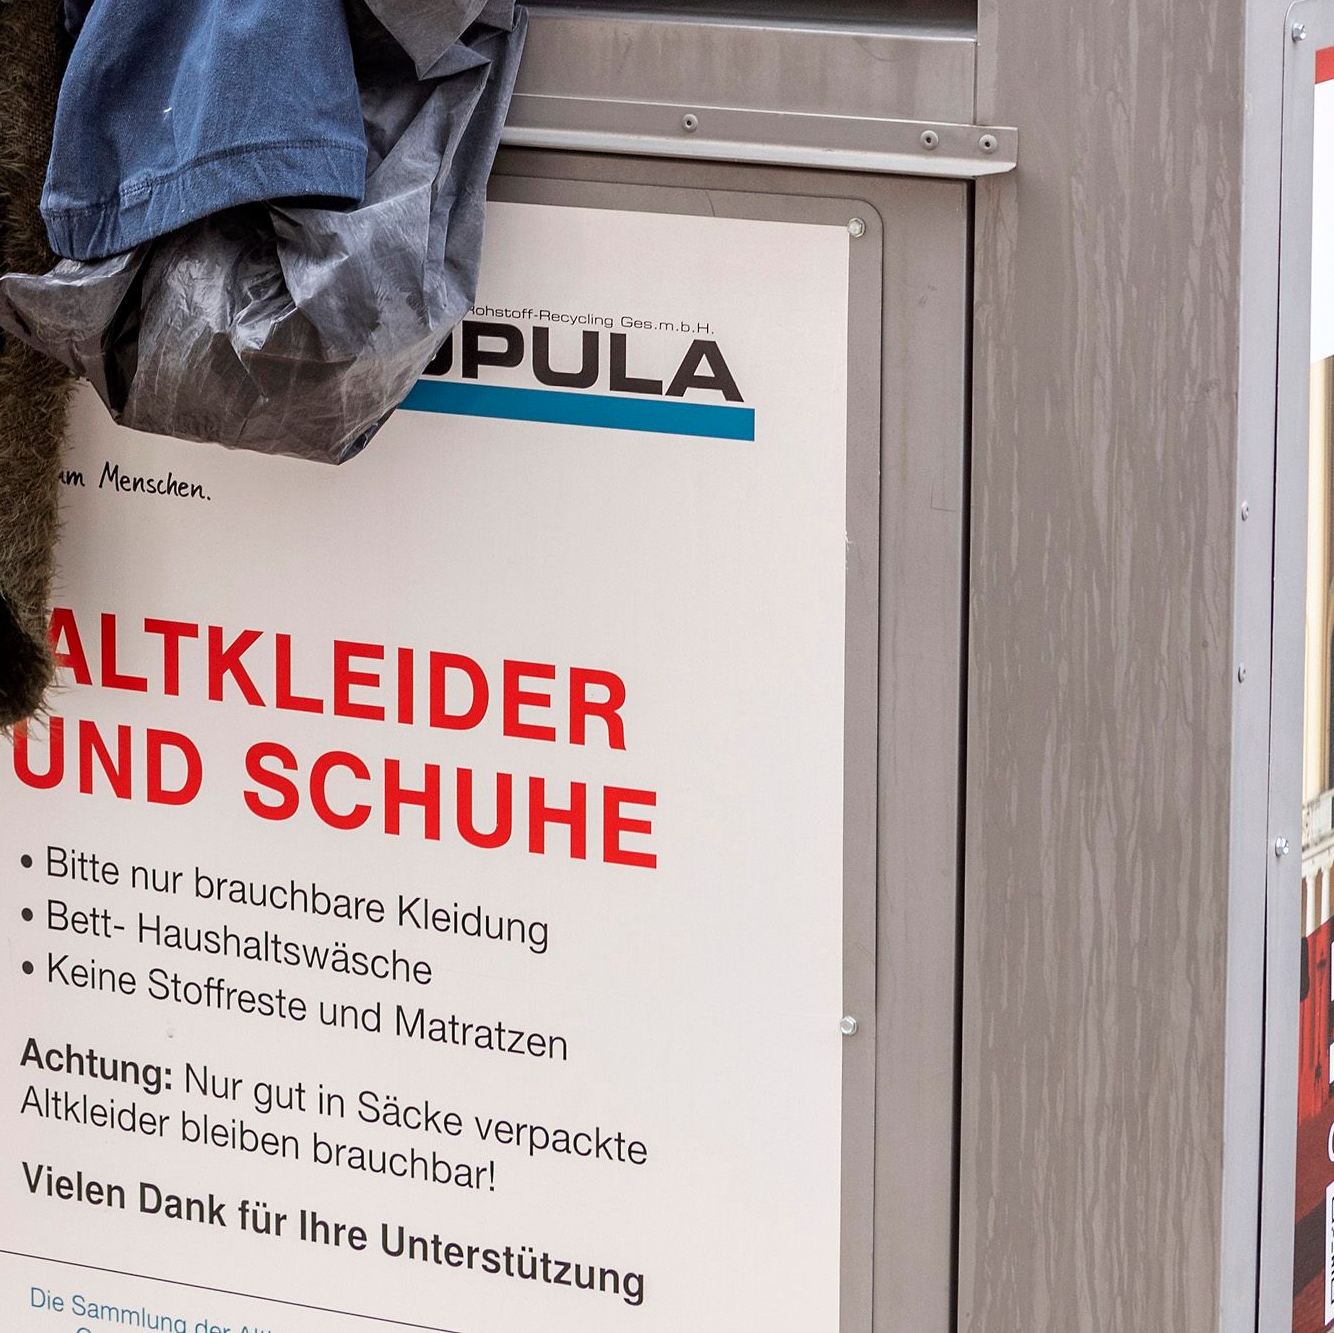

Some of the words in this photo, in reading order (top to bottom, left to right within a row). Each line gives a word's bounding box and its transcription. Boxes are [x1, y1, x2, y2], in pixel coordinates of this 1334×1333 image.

[620, 316, 715, 335] Ges.m.b.H.
[98, 461, 211, 501] Menschen.
[45, 606, 628, 752] ALTKLEIDER
[12, 712, 203, 807] UND
[243, 741, 658, 870] SCHUHE
[45, 845, 120, 887] Bitte
[130, 865, 183, 897] nur
[194, 866, 386, 925] brauchbare
[397, 894, 550, 954] Kleidung
[45, 900, 126, 939] Bett-
[137, 912, 434, 986] Haushaltswäsche
[45, 953, 137, 996] Keine
[147, 966, 308, 1022] Stoffreste
[319, 1002, 382, 1034] und
[395, 1003, 569, 1062] Matratzen
[19, 1037, 174, 1096] Achtung:
[183, 1062, 243, 1102] Nur
[253, 1079, 307, 1115] gut
[317, 1081, 346, 1118] in
[357, 1089, 464, 1137] Säcke
[474, 1111, 649, 1165] verpackte
[19, 1085, 171, 1138] Altkleider
[181, 1109, 301, 1160] bleiben
[313, 1133, 497, 1193] brauchbar!
[20, 1161, 127, 1211] Vielen
[137, 1181, 228, 1229] Dank
[237, 1198, 289, 1239] für
[299, 1208, 369, 1252] Ihre
[380, 1223, 647, 1308] Unterstützung
[30, 1287, 65, 1312] Die
[71, 1294, 187, 1333] Sammlung
